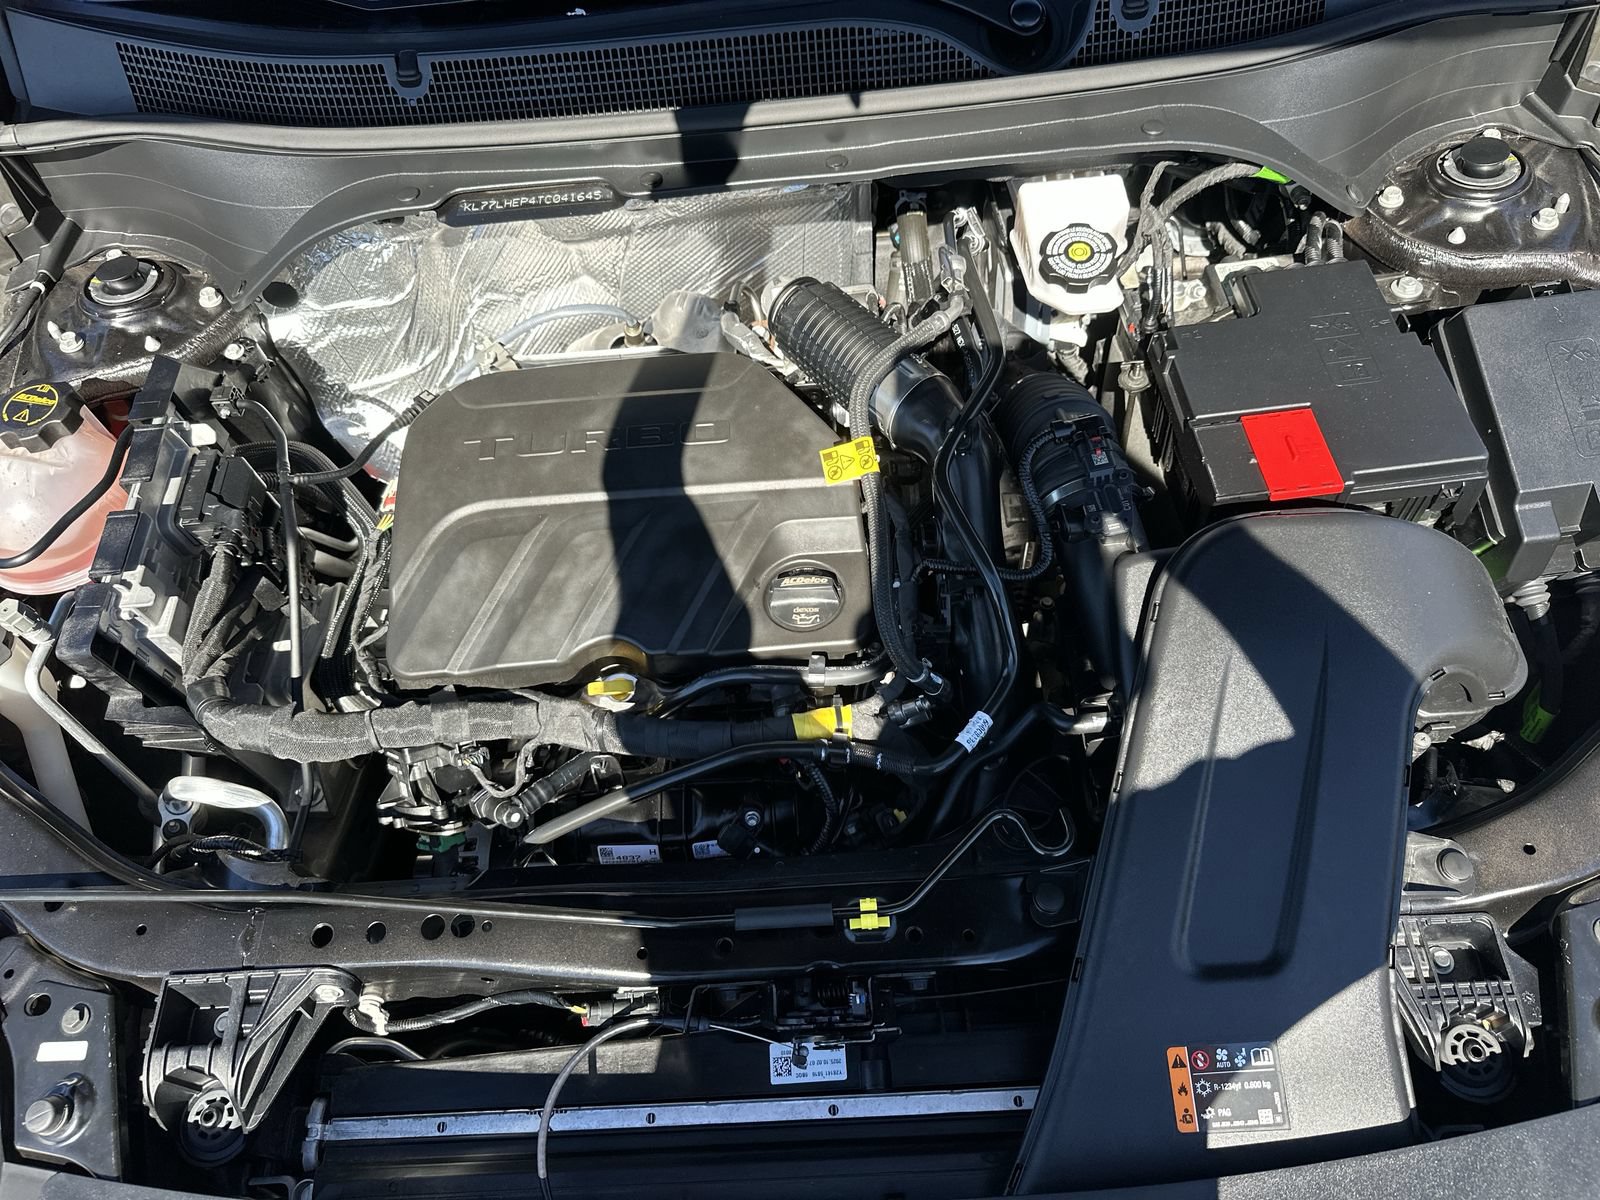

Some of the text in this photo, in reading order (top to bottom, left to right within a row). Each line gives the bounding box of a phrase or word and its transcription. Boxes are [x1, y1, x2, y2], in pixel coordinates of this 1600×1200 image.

[463, 190, 602, 212] KL77LHEP4TC041645
[463, 420, 731, 461] TURBO
[780, 576, 829, 587] ACDelco
[793, 606, 820, 614] dexos
[1216, 1061, 1232, 1069] AUTO
[1217, 1107, 1232, 1117] PAG
